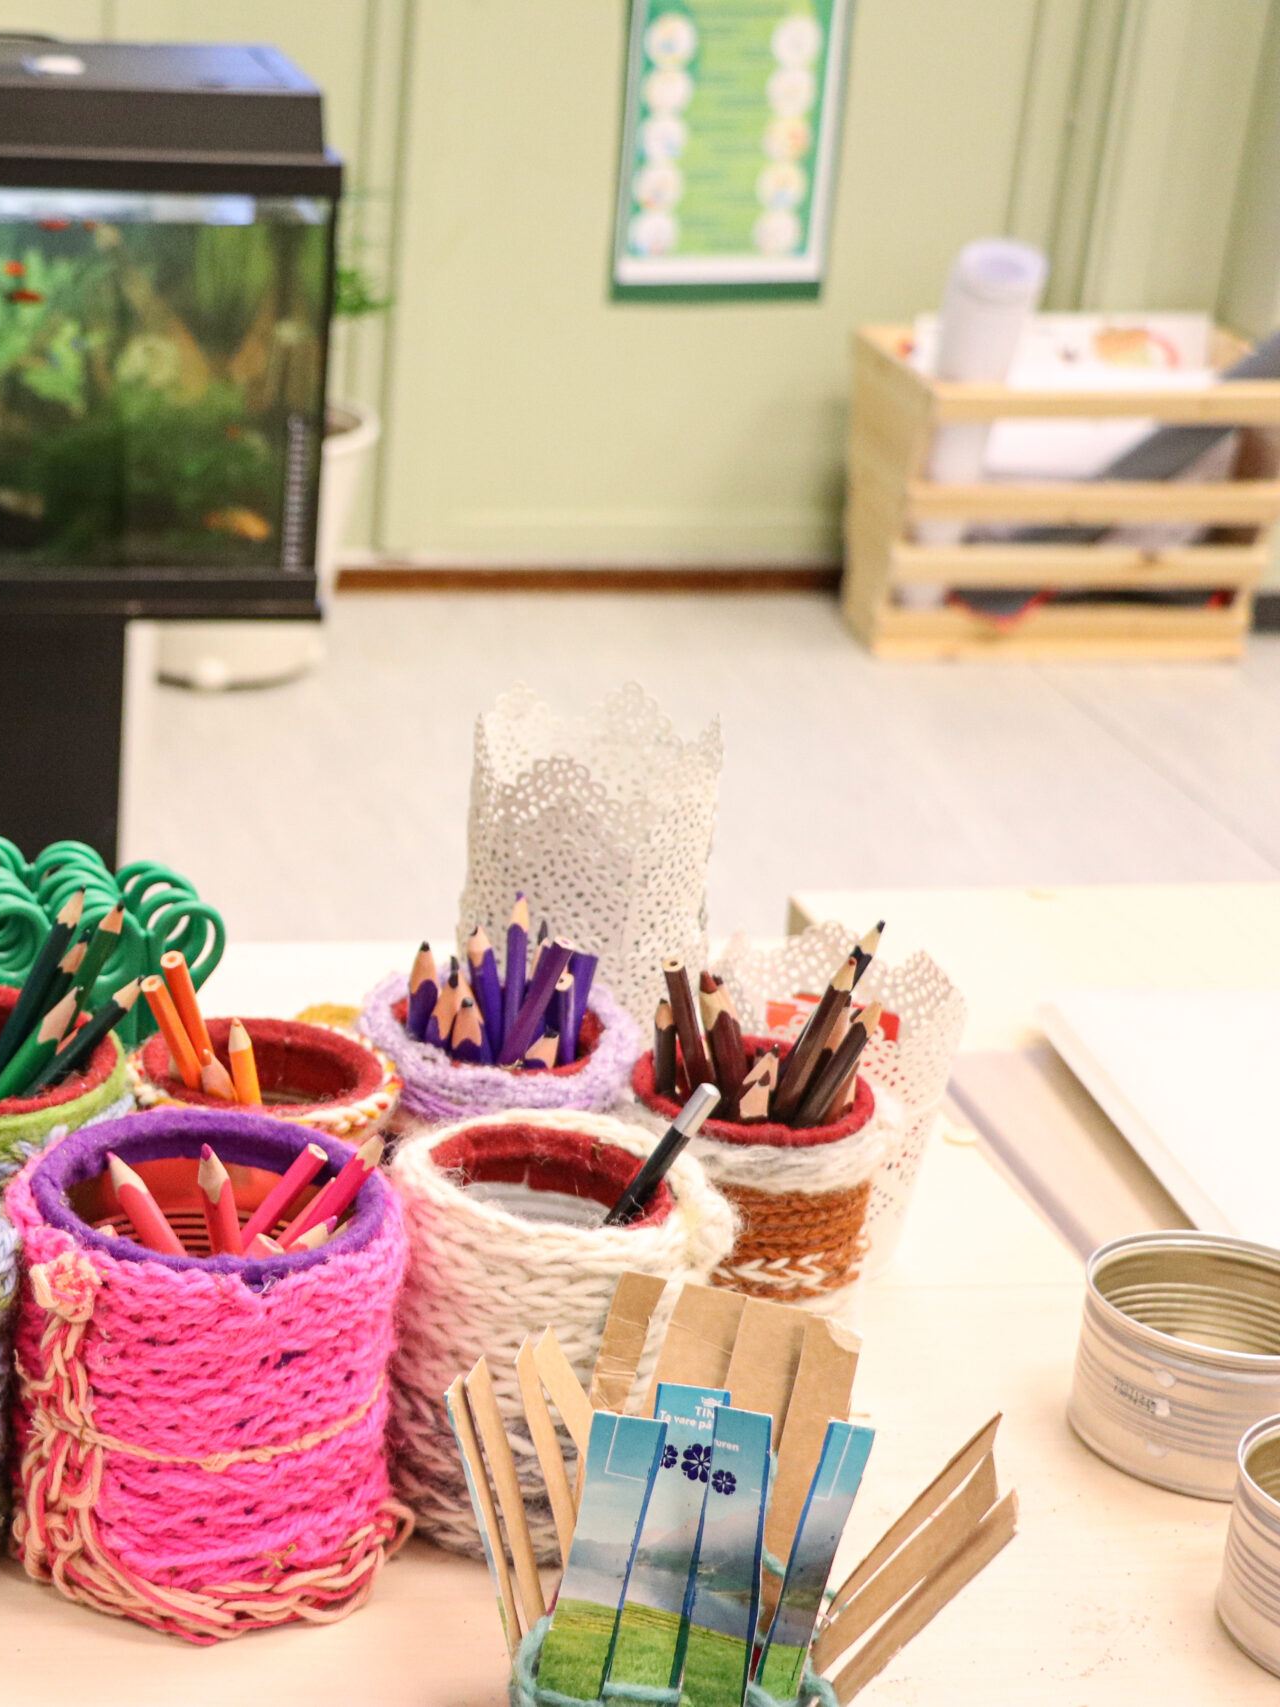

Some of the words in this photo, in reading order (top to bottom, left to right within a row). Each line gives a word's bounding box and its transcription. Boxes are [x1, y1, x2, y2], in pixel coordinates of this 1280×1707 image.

[695, 1405, 715, 1419] TIN
[674, 1415, 697, 1427] vare
[714, 1438, 739, 1452] uren
